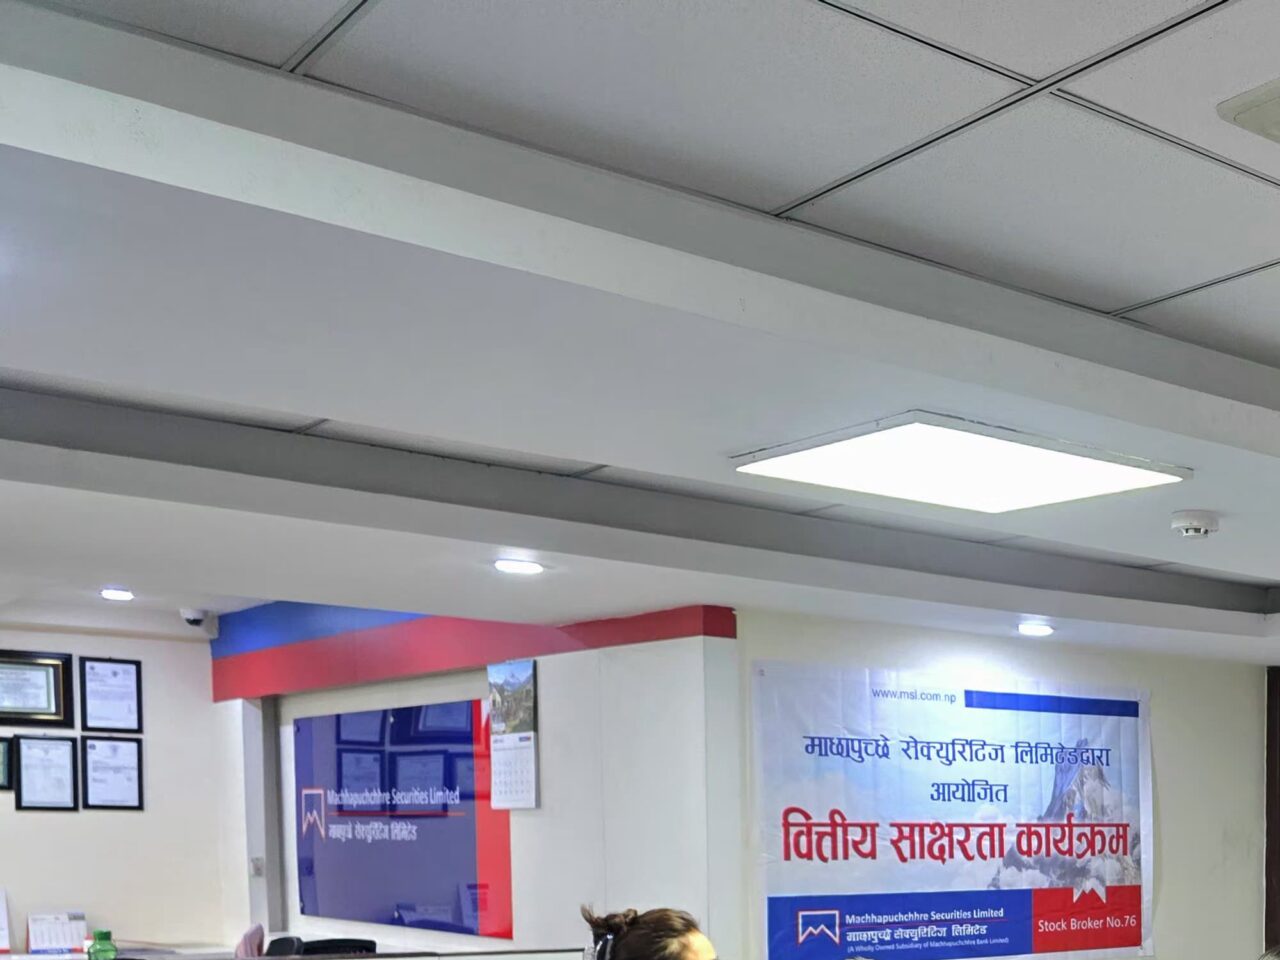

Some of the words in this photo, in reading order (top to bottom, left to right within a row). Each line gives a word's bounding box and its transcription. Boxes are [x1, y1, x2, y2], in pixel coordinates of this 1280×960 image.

[391, 787, 429, 804] Securities
[429, 786, 461, 804] Limited
[930, 779, 1008, 803] आयोजित
[782, 806, 879, 863] वित्तीय
[889, 822, 1007, 865] साक्षरता
[1016, 812, 1130, 859] कार्यक्रम
[845, 910, 928, 924] Machhapuchchhre
[930, 909, 972, 921] Securities
[973, 907, 1004, 919] Limited
[1038, 918, 1067, 932] Stock
[1070, 916, 1104, 930] Broker
[1106, 914, 1137, 928] No.76
